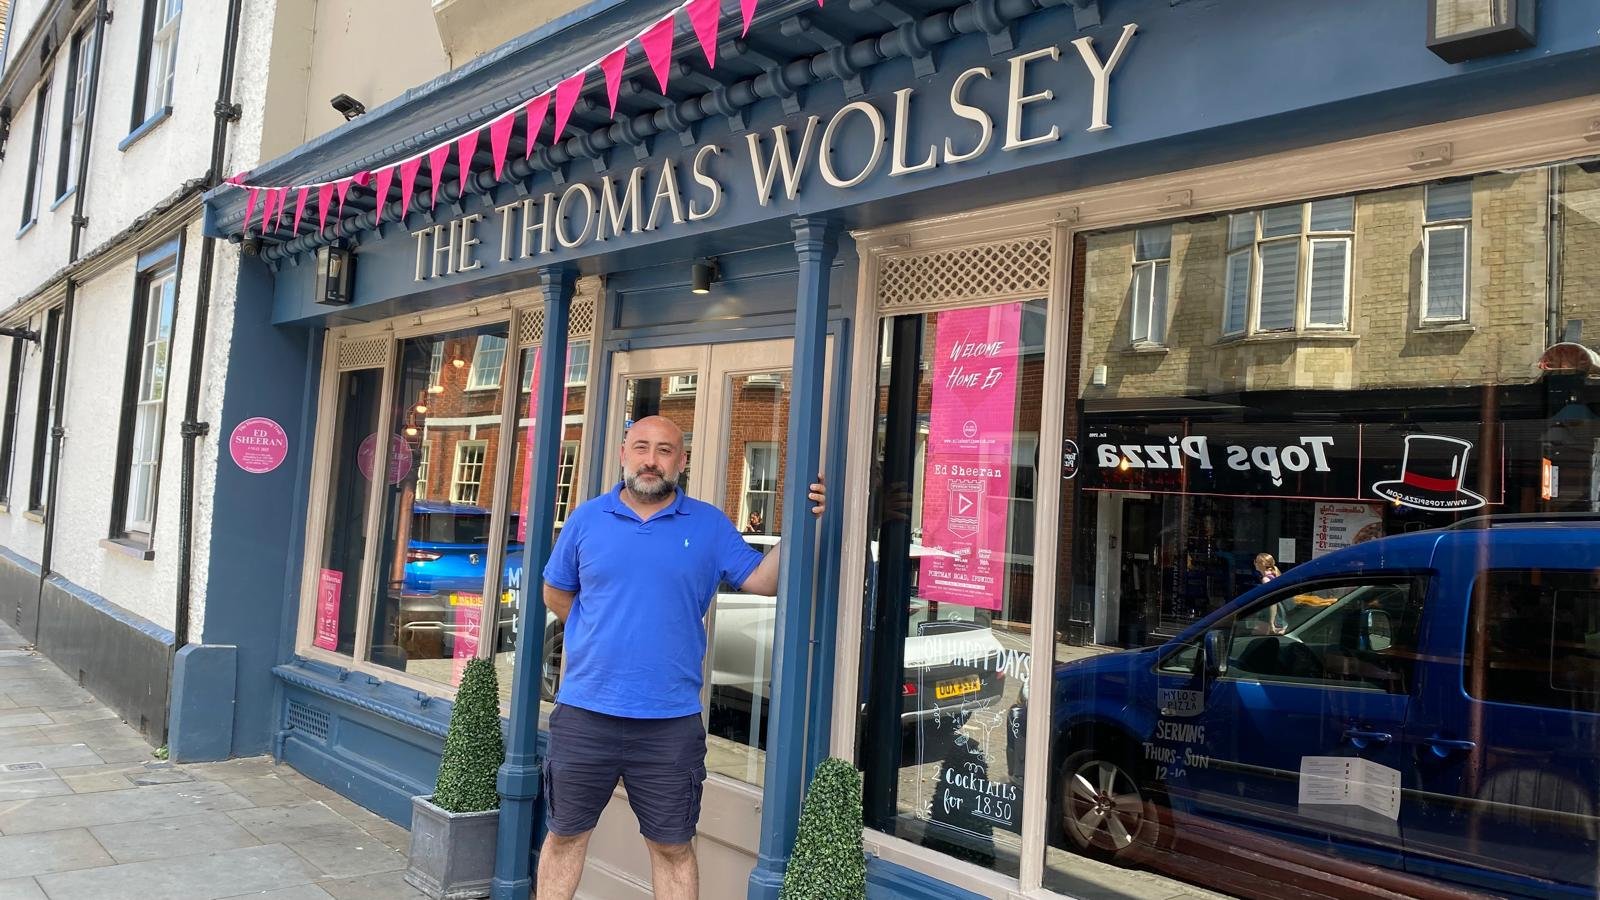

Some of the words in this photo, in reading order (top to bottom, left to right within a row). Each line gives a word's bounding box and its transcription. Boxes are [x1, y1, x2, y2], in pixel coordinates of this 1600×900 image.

[411, 213, 486, 281] THE
[495, 144, 724, 263] THOMAS
[744, 22, 1139, 207] WOLSEY
[235, 436, 282, 446] SHEERAN
[934, 465, 947, 476] Ed
[951, 465, 1002, 477] Sheeran
[1156, 720, 1205, 744] SERVING
[943, 788, 964, 814] for
